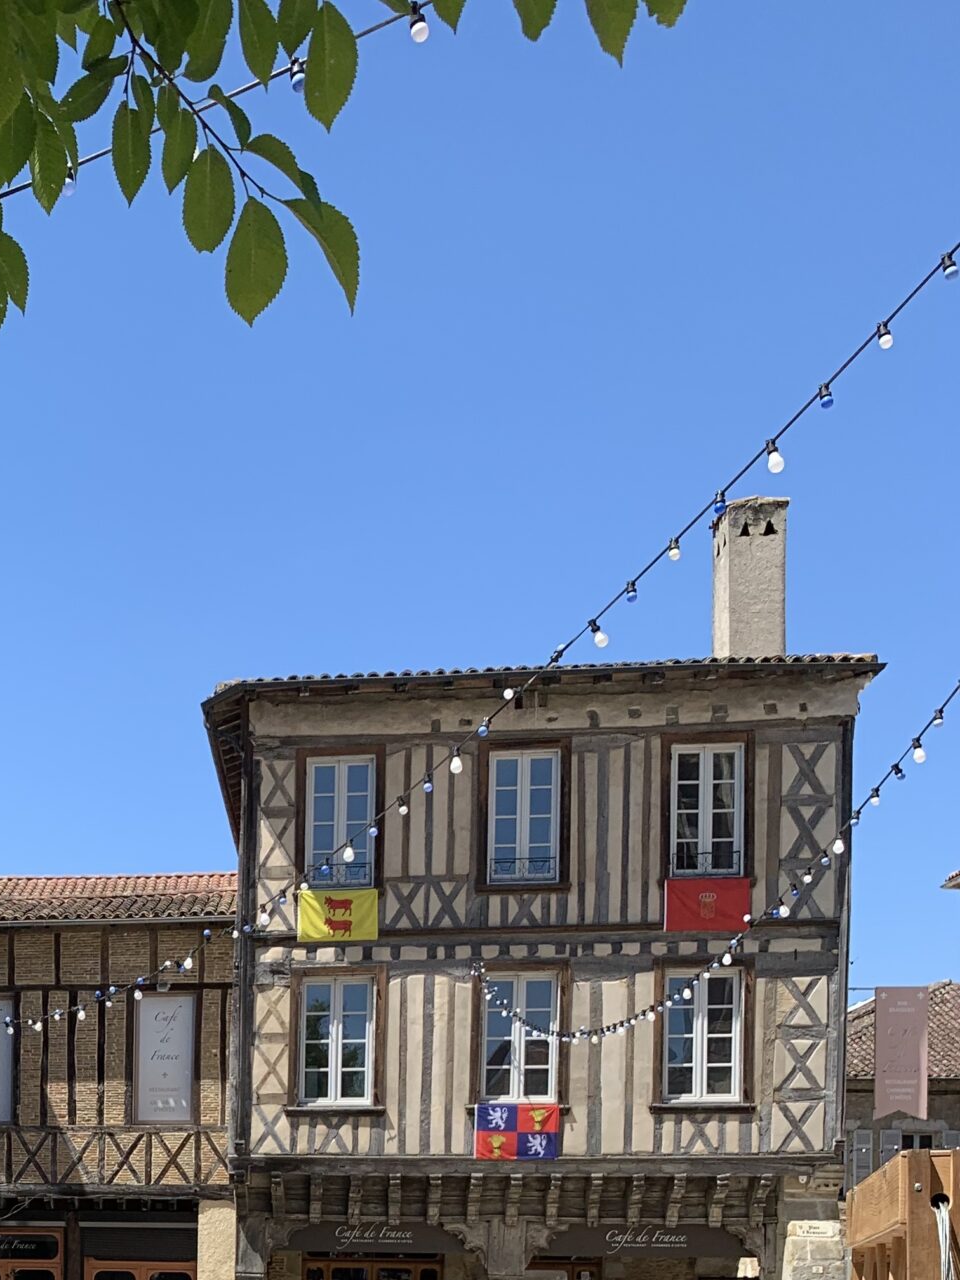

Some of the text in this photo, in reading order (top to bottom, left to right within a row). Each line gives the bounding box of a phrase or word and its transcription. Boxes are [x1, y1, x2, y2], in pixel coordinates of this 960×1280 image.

[159, 1028, 173, 1043] de
[150, 1050, 180, 1061] France
[335, 1221, 413, 1249] Café de France
[605, 1224, 688, 1254] Café de France
